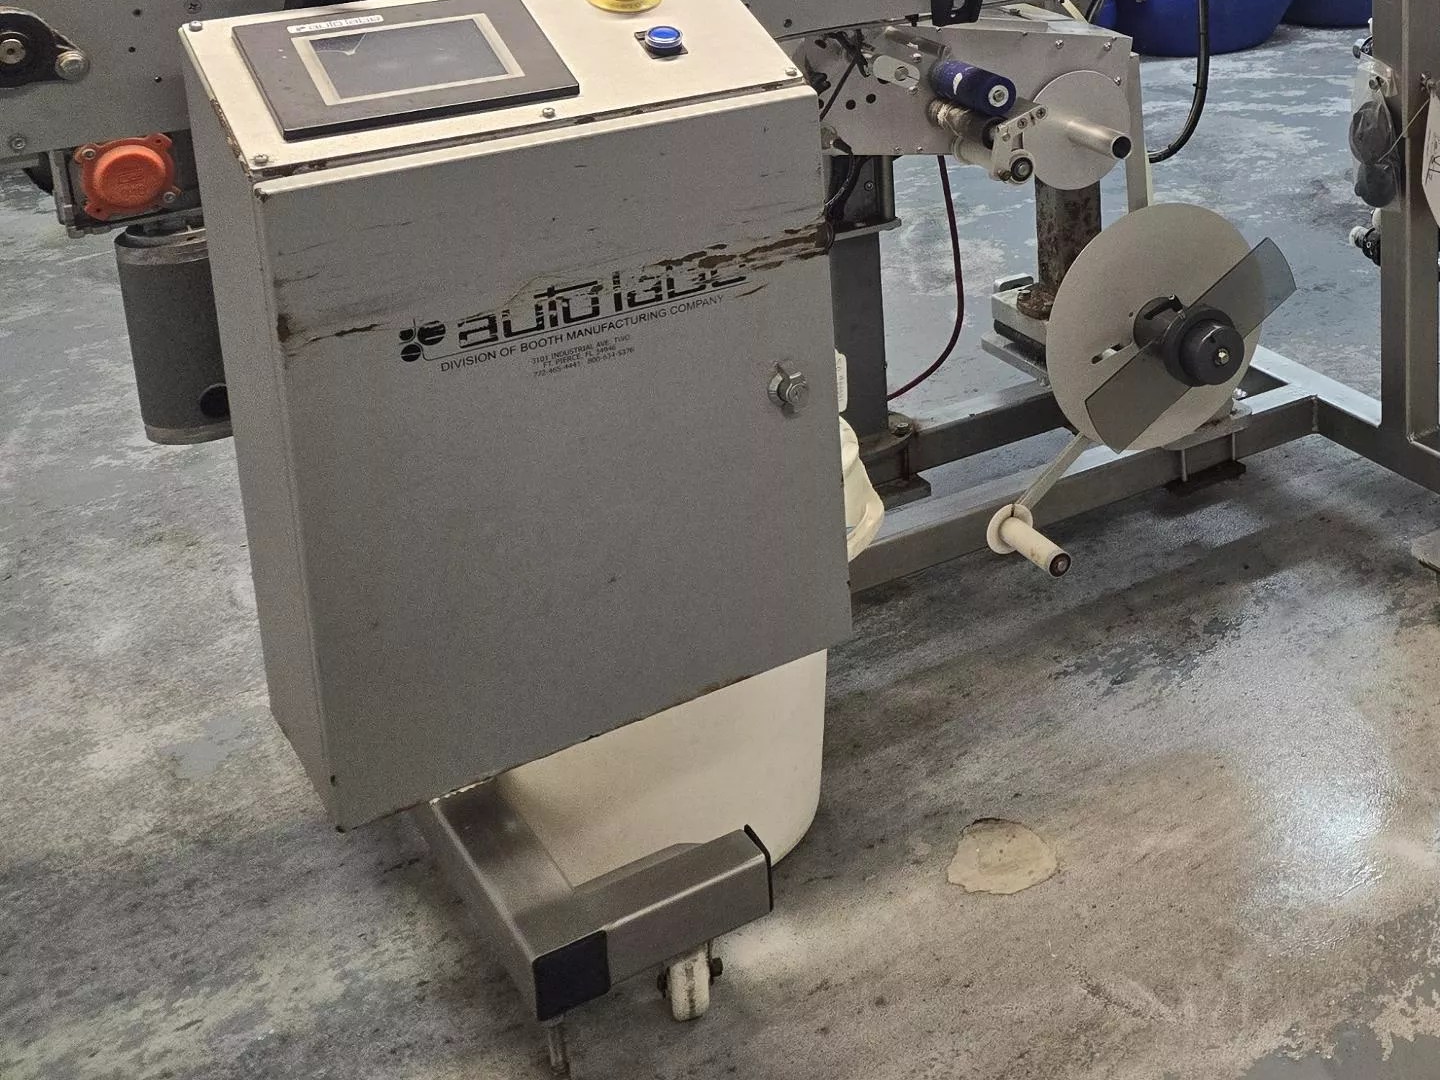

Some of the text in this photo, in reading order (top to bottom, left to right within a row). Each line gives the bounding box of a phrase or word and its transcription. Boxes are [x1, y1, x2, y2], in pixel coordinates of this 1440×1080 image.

[440, 295, 724, 372] DIVISION OF BOOTH MANUFACTURING COMPANY
[532, 355, 549, 365] 3101
[551, 344, 594, 360] INDUSTRIAL
